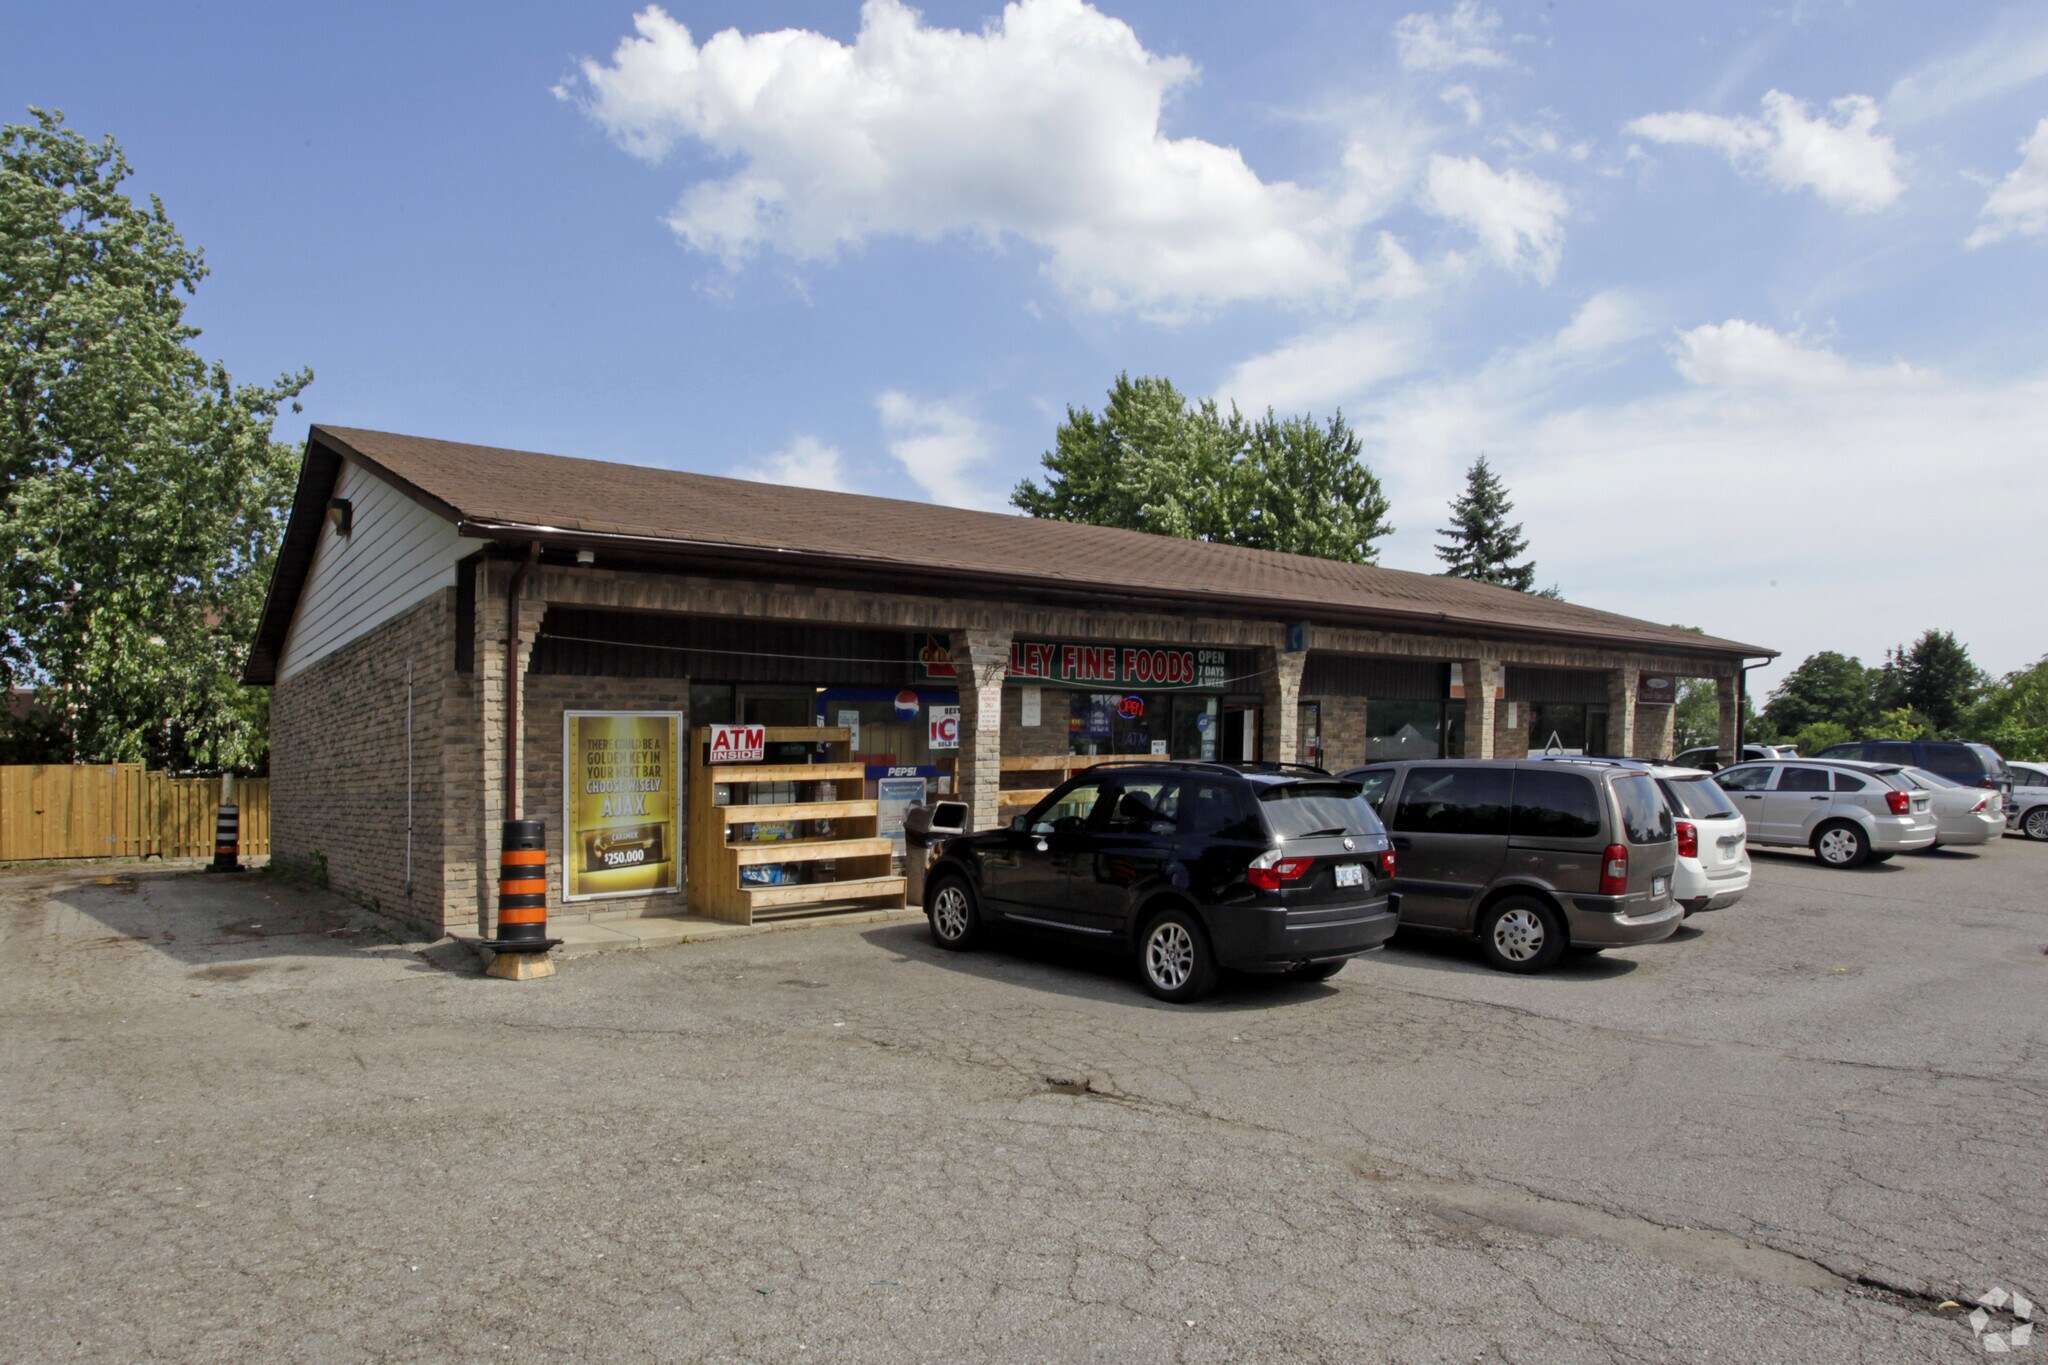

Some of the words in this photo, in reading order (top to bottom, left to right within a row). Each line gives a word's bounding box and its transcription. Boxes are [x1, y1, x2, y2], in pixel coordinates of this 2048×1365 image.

[1004, 642, 1055, 678] LEY
[1061, 645, 1116, 681] FINE
[1122, 648, 1194, 684] FOODS
[1198, 650, 1225, 665] OPEN
[1198, 666, 1203, 676] 7
[1205, 666, 1225, 677] DAYS
[1205, 678, 1225, 688] WEEK
[1119, 698, 1144, 716] OPEN
[587, 739, 613, 750] THERE
[614, 739, 641, 749] COULD
[642, 738, 653, 749] BE
[655, 738, 660, 749] A
[713, 729, 763, 750] ATM
[587, 752, 627, 765] GOLDEN
[629, 752, 648, 763] KEY
[650, 751, 660, 763] IN
[713, 750, 761, 760] INSIDE
[587, 766, 614, 779] YOUR
[616, 766, 640, 778] NEXT
[642, 765, 663, 777] BAR.
[887, 766, 917, 777] PEPSI
[586, 780, 625, 794] CHOOSE
[628, 779, 661, 792] WISELY
[601, 794, 650, 817] AJAX.
[604, 849, 644, 865] $250,000
